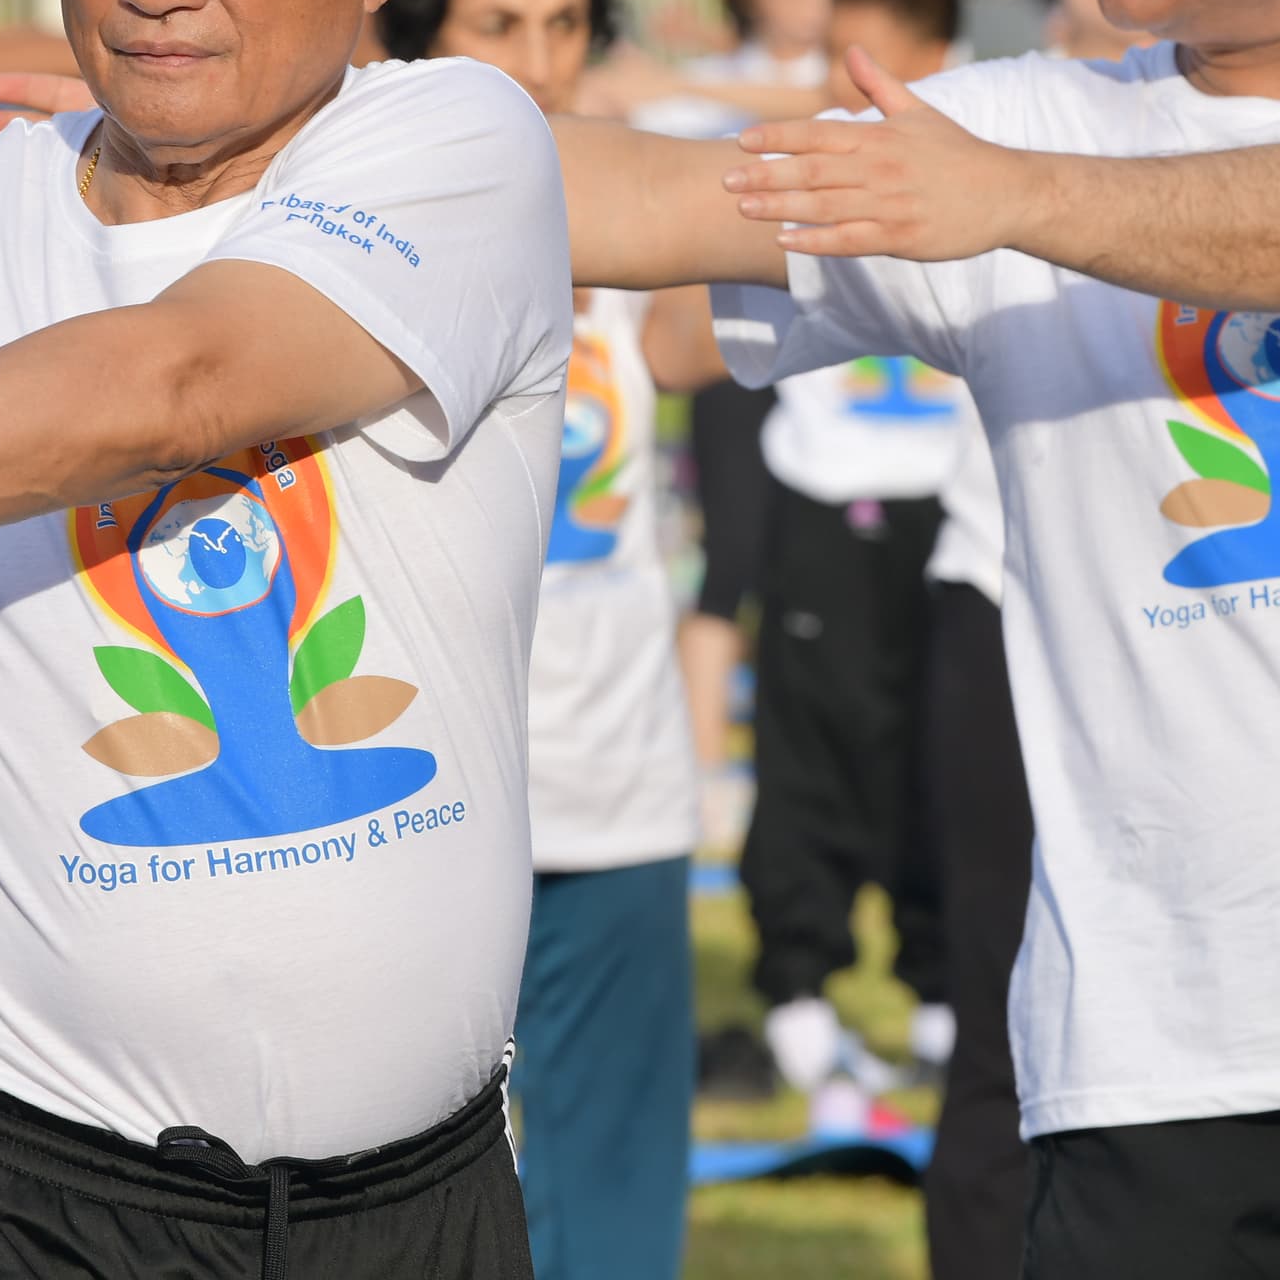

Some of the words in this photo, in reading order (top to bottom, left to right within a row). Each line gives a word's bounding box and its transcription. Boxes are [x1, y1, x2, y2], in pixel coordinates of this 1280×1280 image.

[286, 213, 375, 255] ngkok
[353, 211, 377, 228] of
[376, 224, 421, 268] India
[1142, 603, 1206, 629] Yoga
[1213, 593, 1240, 617] for
[59, 853, 138, 892] Yoga
[148, 851, 196, 882] for
[207, 831, 357, 879] Harmony
[367, 819, 388, 848] &
[395, 800, 466, 838] Peace
